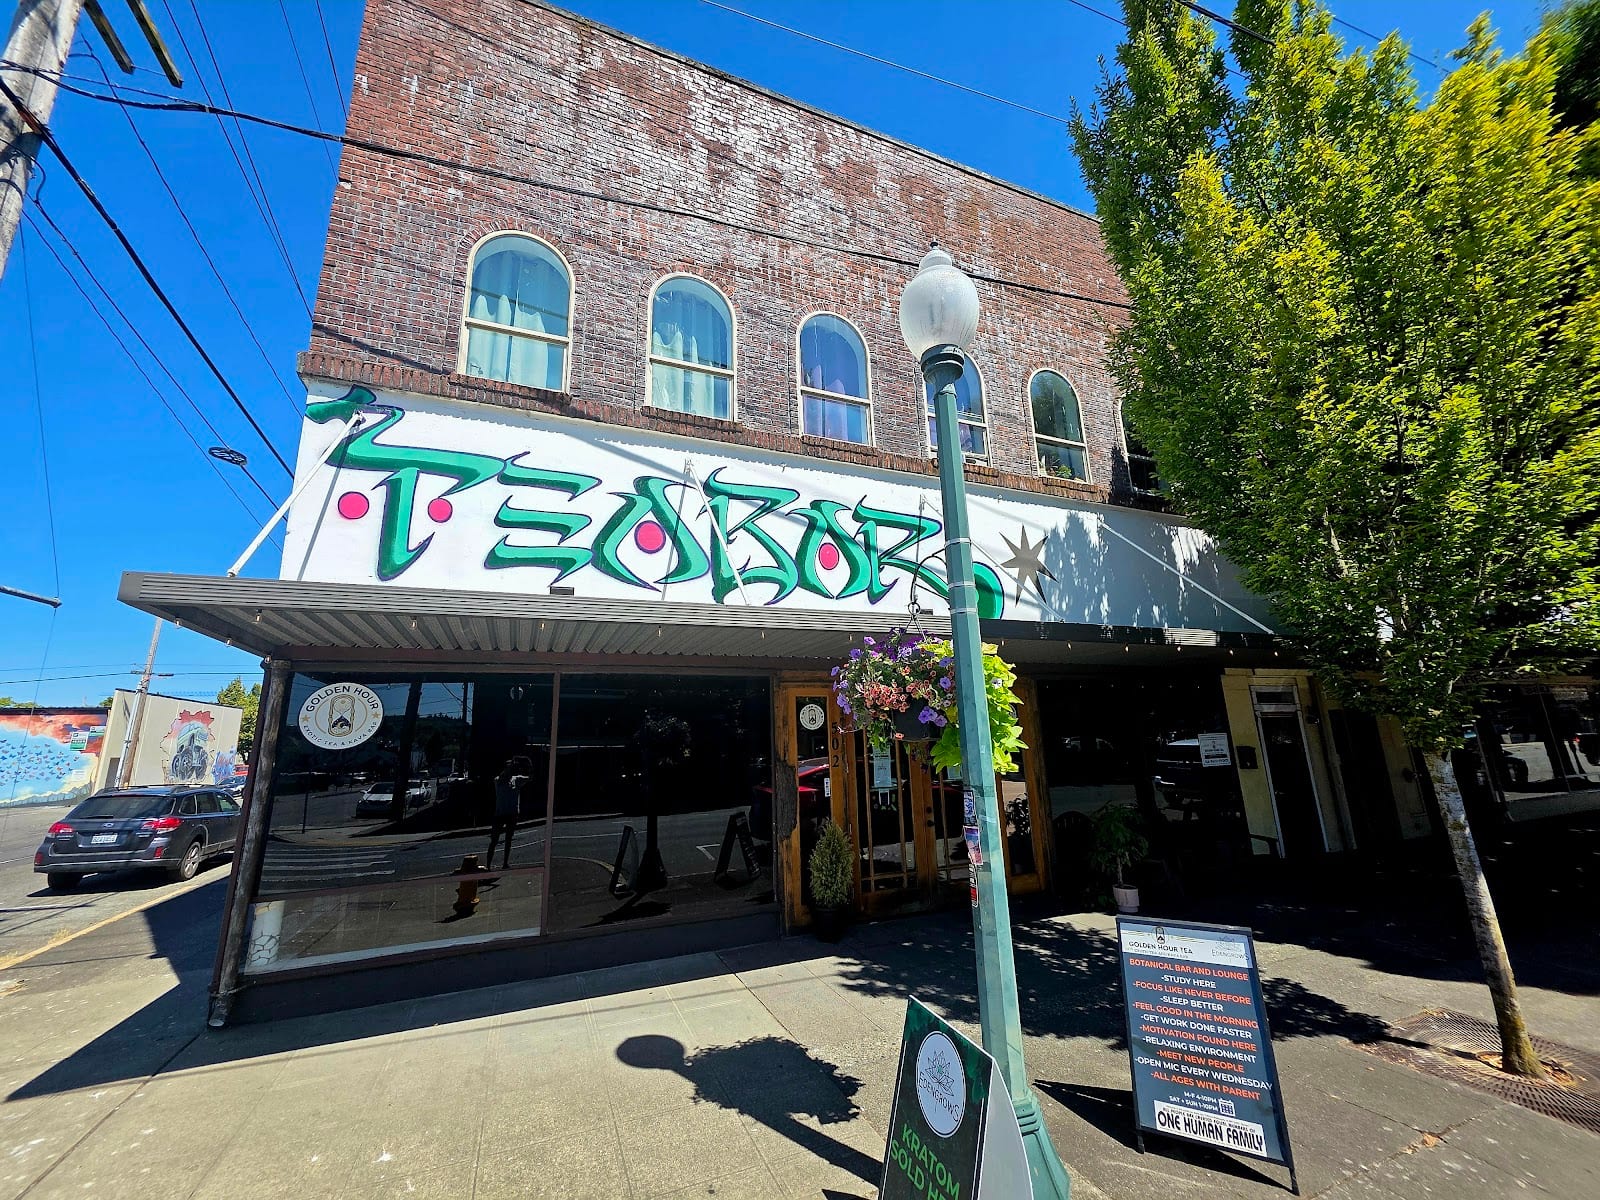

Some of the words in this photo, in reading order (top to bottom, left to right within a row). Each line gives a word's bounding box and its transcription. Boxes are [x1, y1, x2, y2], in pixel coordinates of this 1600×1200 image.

[306, 685, 351, 712] GOLDEN
[353, 687, 379, 710] HOUR
[303, 725, 322, 742] EXOTIC
[348, 733, 367, 745] KAVA
[1128, 941, 1156, 950] GOLDEN
[1157, 944, 1179, 953] HOUR
[1129, 958, 1174, 971] BOTANICAL
[1175, 964, 1192, 974] BAR
[1193, 967, 1211, 976] AND
[1213, 969, 1249, 981] LOUNGE
[1161, 974, 1191, 985] -STUDY
[1193, 979, 1217, 989] HERE
[1133, 980, 1163, 991] -FOCUS
[1164, 985, 1183, 995] LIKE
[1184, 988, 1213, 999] NEVER
[1215, 992, 1252, 1005] BEFORE
[1160, 995, 1189, 1006] -SLEEP
[1190, 1000, 1224, 1012] BETTER
[1132, 1001, 1155, 1012] -FEEL
[1156, 1005, 1182, 1016] GOOD
[1183, 1010, 1193, 1018] IN
[1194, 1011, 1213, 1021] THE
[1214, 1015, 1259, 1029] MORNING
[1140, 1014, 1159, 1023] -GET
[1161, 1016, 1189, 1028] WORK
[1190, 1021, 1217, 1033] DONE
[1217, 1026, 1253, 1040] FASTER
[1139, 1024, 1196, 1041] -MOTIVATION
[1197, 1034, 1230, 1047] FOUND
[1231, 1040, 1257, 1052] HERE
[1142, 1035, 1188, 1051] -RELAXING
[1189, 1044, 1257, 1064] ENVIRONMENT
[1134, 1056, 1162, 1068] -OPEN
[1163, 1061, 1180, 1072] MIC
[1181, 1065, 1210, 1078] EVERY
[1211, 1070, 1273, 1091] WEDNESDAY
[1156, 1050, 1183, 1061] -MEET
[1184, 1054, 1206, 1065] NEW
[1208, 1058, 1245, 1073] PEOPLE
[1151, 1071, 1170, 1081] -ALL
[1171, 1074, 1195, 1086] AGES
[1196, 1080, 1220, 1092] WITH
[1222, 1085, 1261, 1101] PARENT
[1169, 1095, 1180, 1103] SAT
[1158, 1110, 1181, 1131] ONE
[1184, 1117, 1224, 1142] HUMAN
[1226, 1127, 1264, 1152] FAMILY
[890, 1139, 925, 1191] SOLD
[902, 1123, 960, 1200] KRATOM
